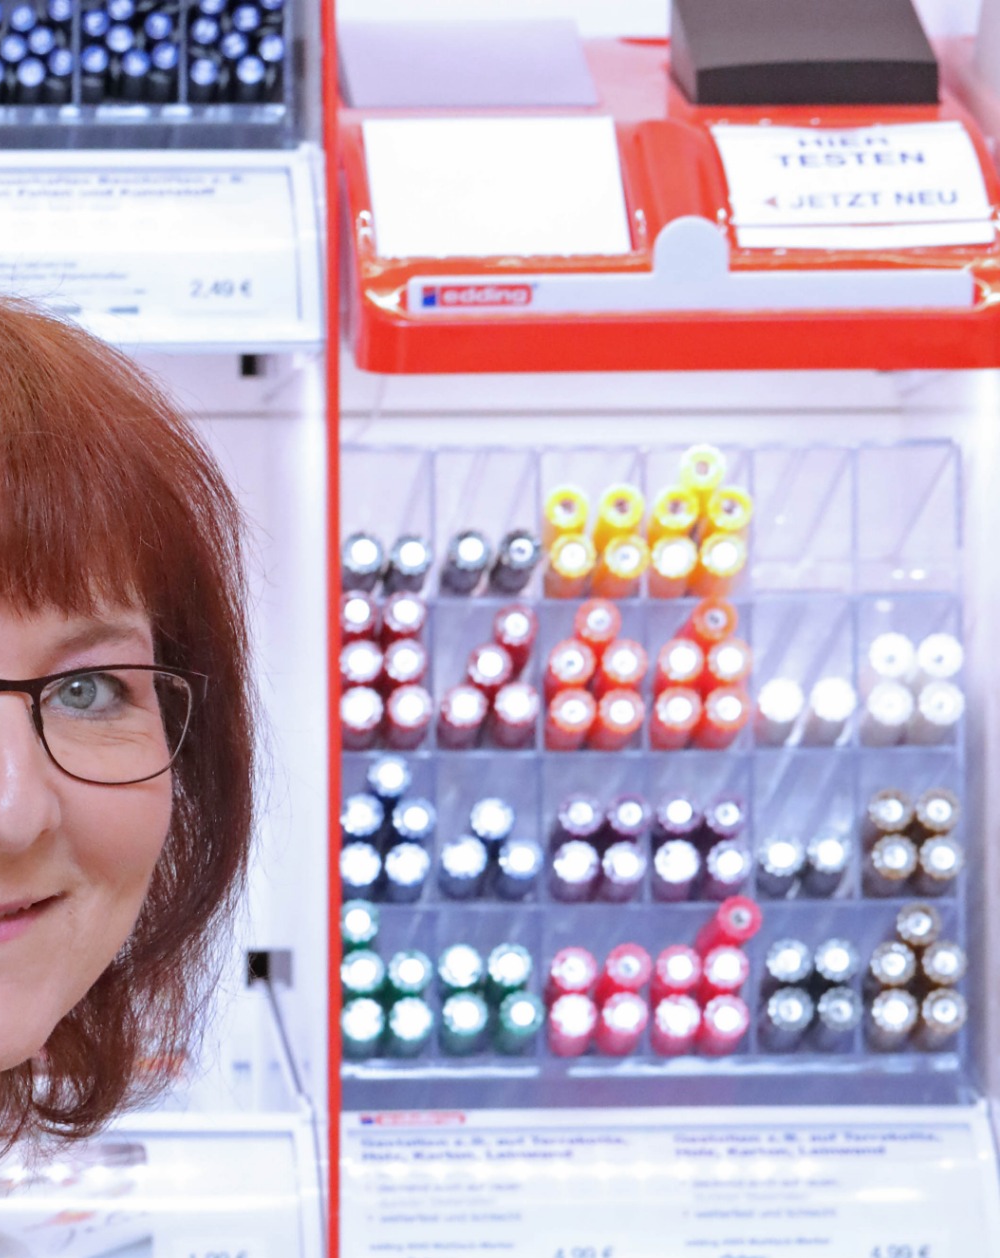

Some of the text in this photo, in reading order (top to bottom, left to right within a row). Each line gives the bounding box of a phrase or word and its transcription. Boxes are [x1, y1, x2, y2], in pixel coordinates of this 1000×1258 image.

[776, 151, 927, 169] TESTEN
[790, 190, 959, 209] JETZT NEU
[443, 287, 528, 305] edding
